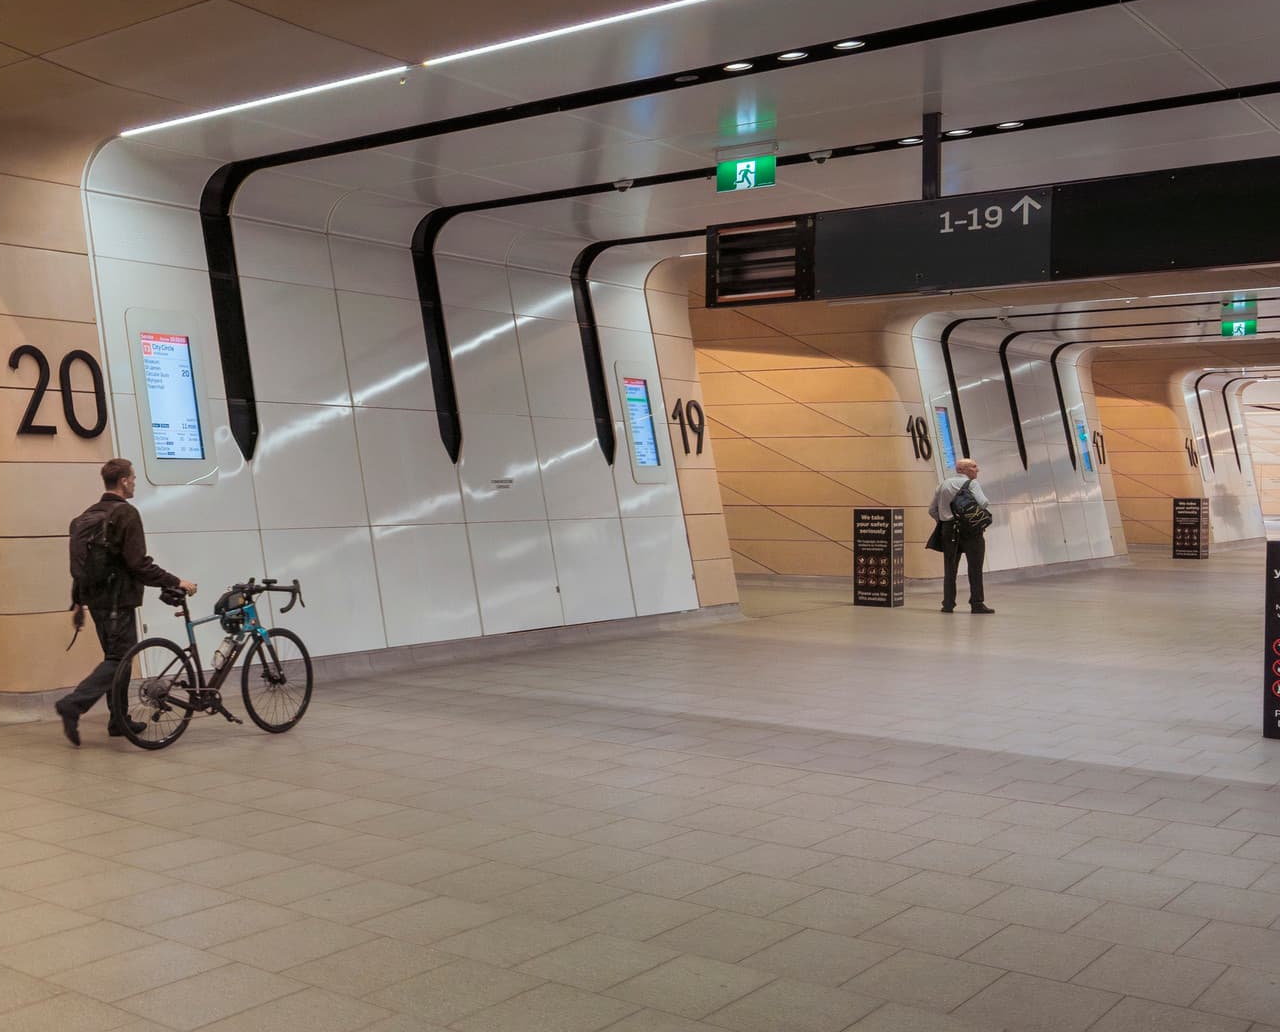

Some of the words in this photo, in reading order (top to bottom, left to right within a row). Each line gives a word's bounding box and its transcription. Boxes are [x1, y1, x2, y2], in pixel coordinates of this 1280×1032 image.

[8, 344, 107, 439] 20
[671, 397, 705, 456] 19
[906, 414, 932, 461] 18
